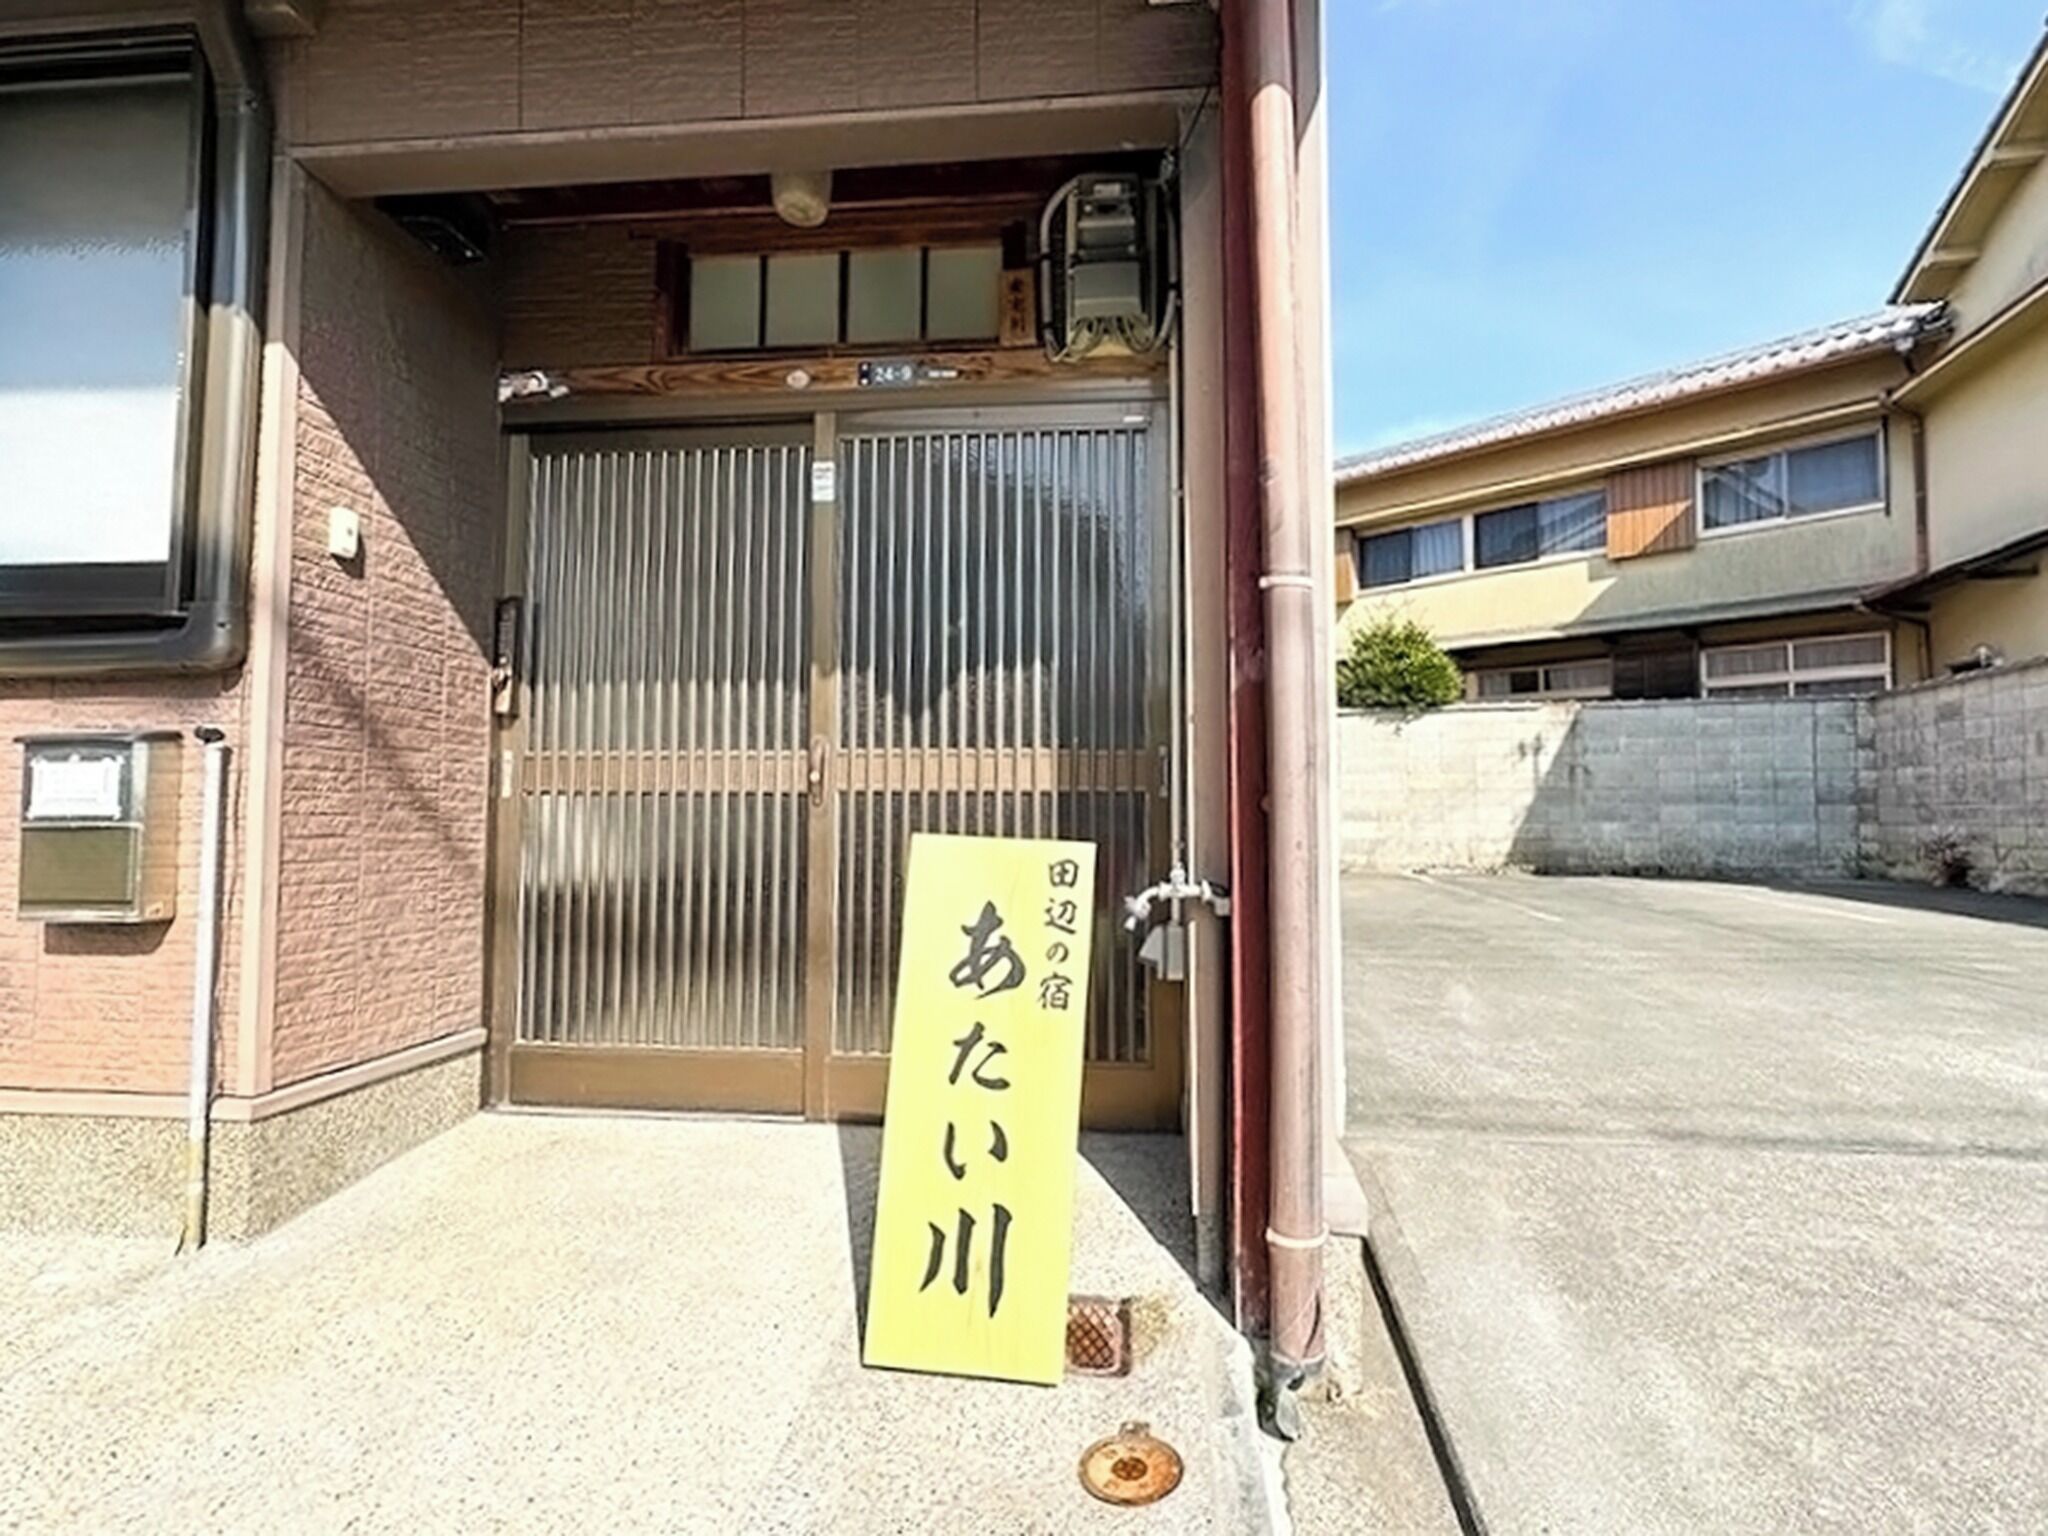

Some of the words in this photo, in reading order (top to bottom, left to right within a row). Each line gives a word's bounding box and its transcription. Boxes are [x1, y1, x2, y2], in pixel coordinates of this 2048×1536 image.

[1037, 858, 1080, 1011] 田辺の宿
[920, 900, 1027, 1319] あたい川
